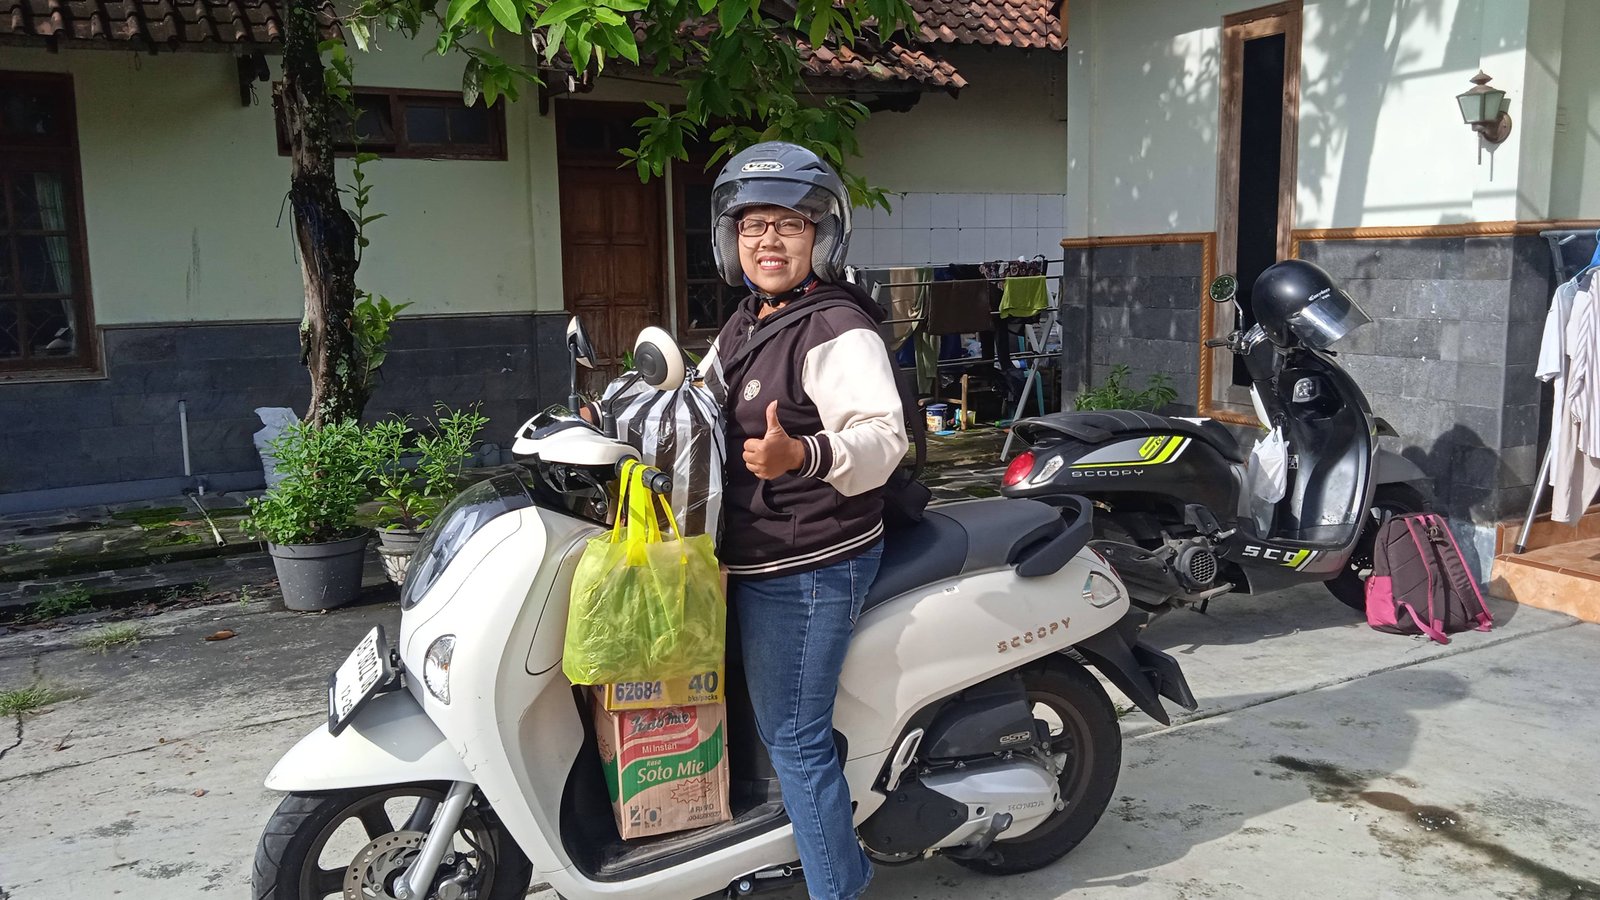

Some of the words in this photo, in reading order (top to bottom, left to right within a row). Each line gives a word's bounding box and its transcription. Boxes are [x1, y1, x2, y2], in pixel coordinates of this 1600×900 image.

[1071, 469, 1144, 478] SCOOPY
[997, 617, 1071, 653] SCOOPY
[616, 681, 661, 701] 62684
[689, 671, 718, 693] 40
[642, 745, 652, 755] Mi
[653, 742, 678, 754] Instan
[637, 765, 673, 784] Soto
[677, 759, 705, 777] Mie
[1008, 801, 1045, 811] HONDA
